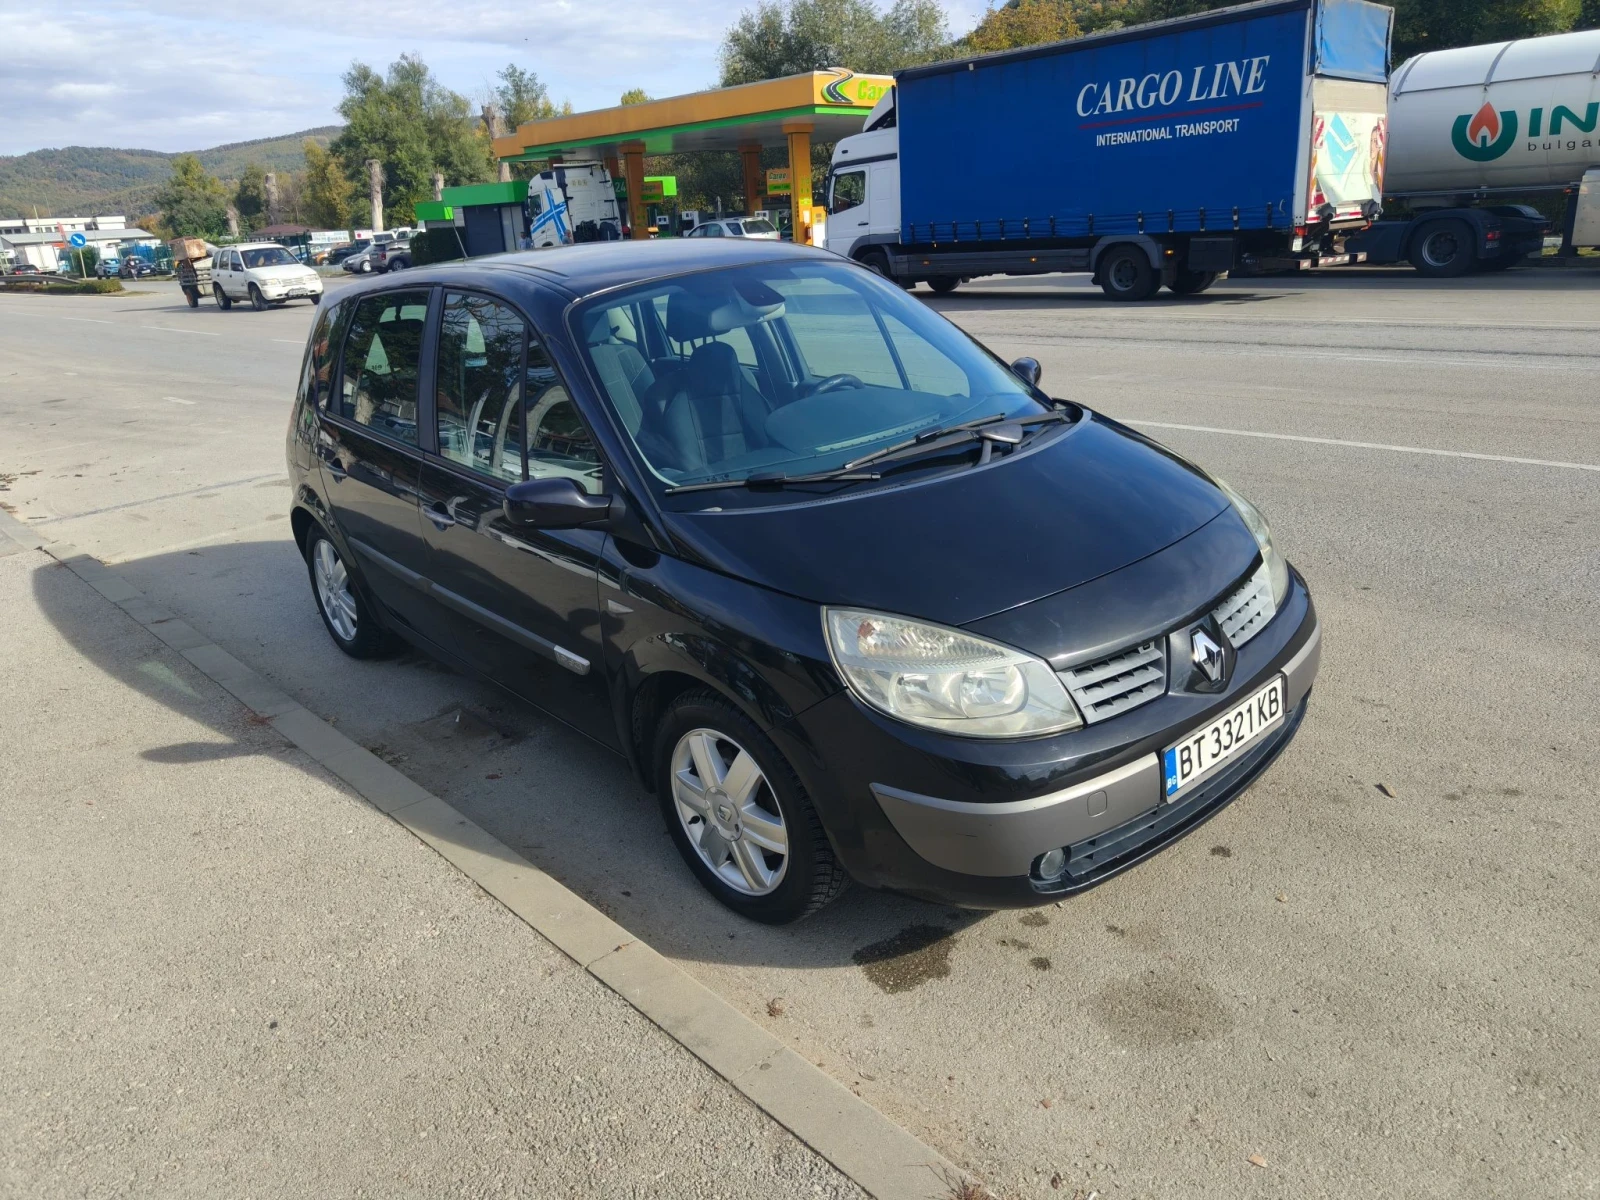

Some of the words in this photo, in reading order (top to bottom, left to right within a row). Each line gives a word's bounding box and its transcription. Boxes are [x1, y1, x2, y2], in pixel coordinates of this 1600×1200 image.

[1076, 70, 1183, 117] CARGO
[1187, 55, 1270, 102] LINE
[1096, 126, 1172, 147] INTERNATIONAL
[1175, 118, 1240, 138] TRANSPORT
[1527, 139, 1600, 151] bulga
[615, 181, 626, 192] 24
[1167, 775, 1177, 789] BG
[1180, 734, 1205, 780] BT
[1211, 703, 1253, 759] 3321
[1257, 686, 1279, 727] KB
